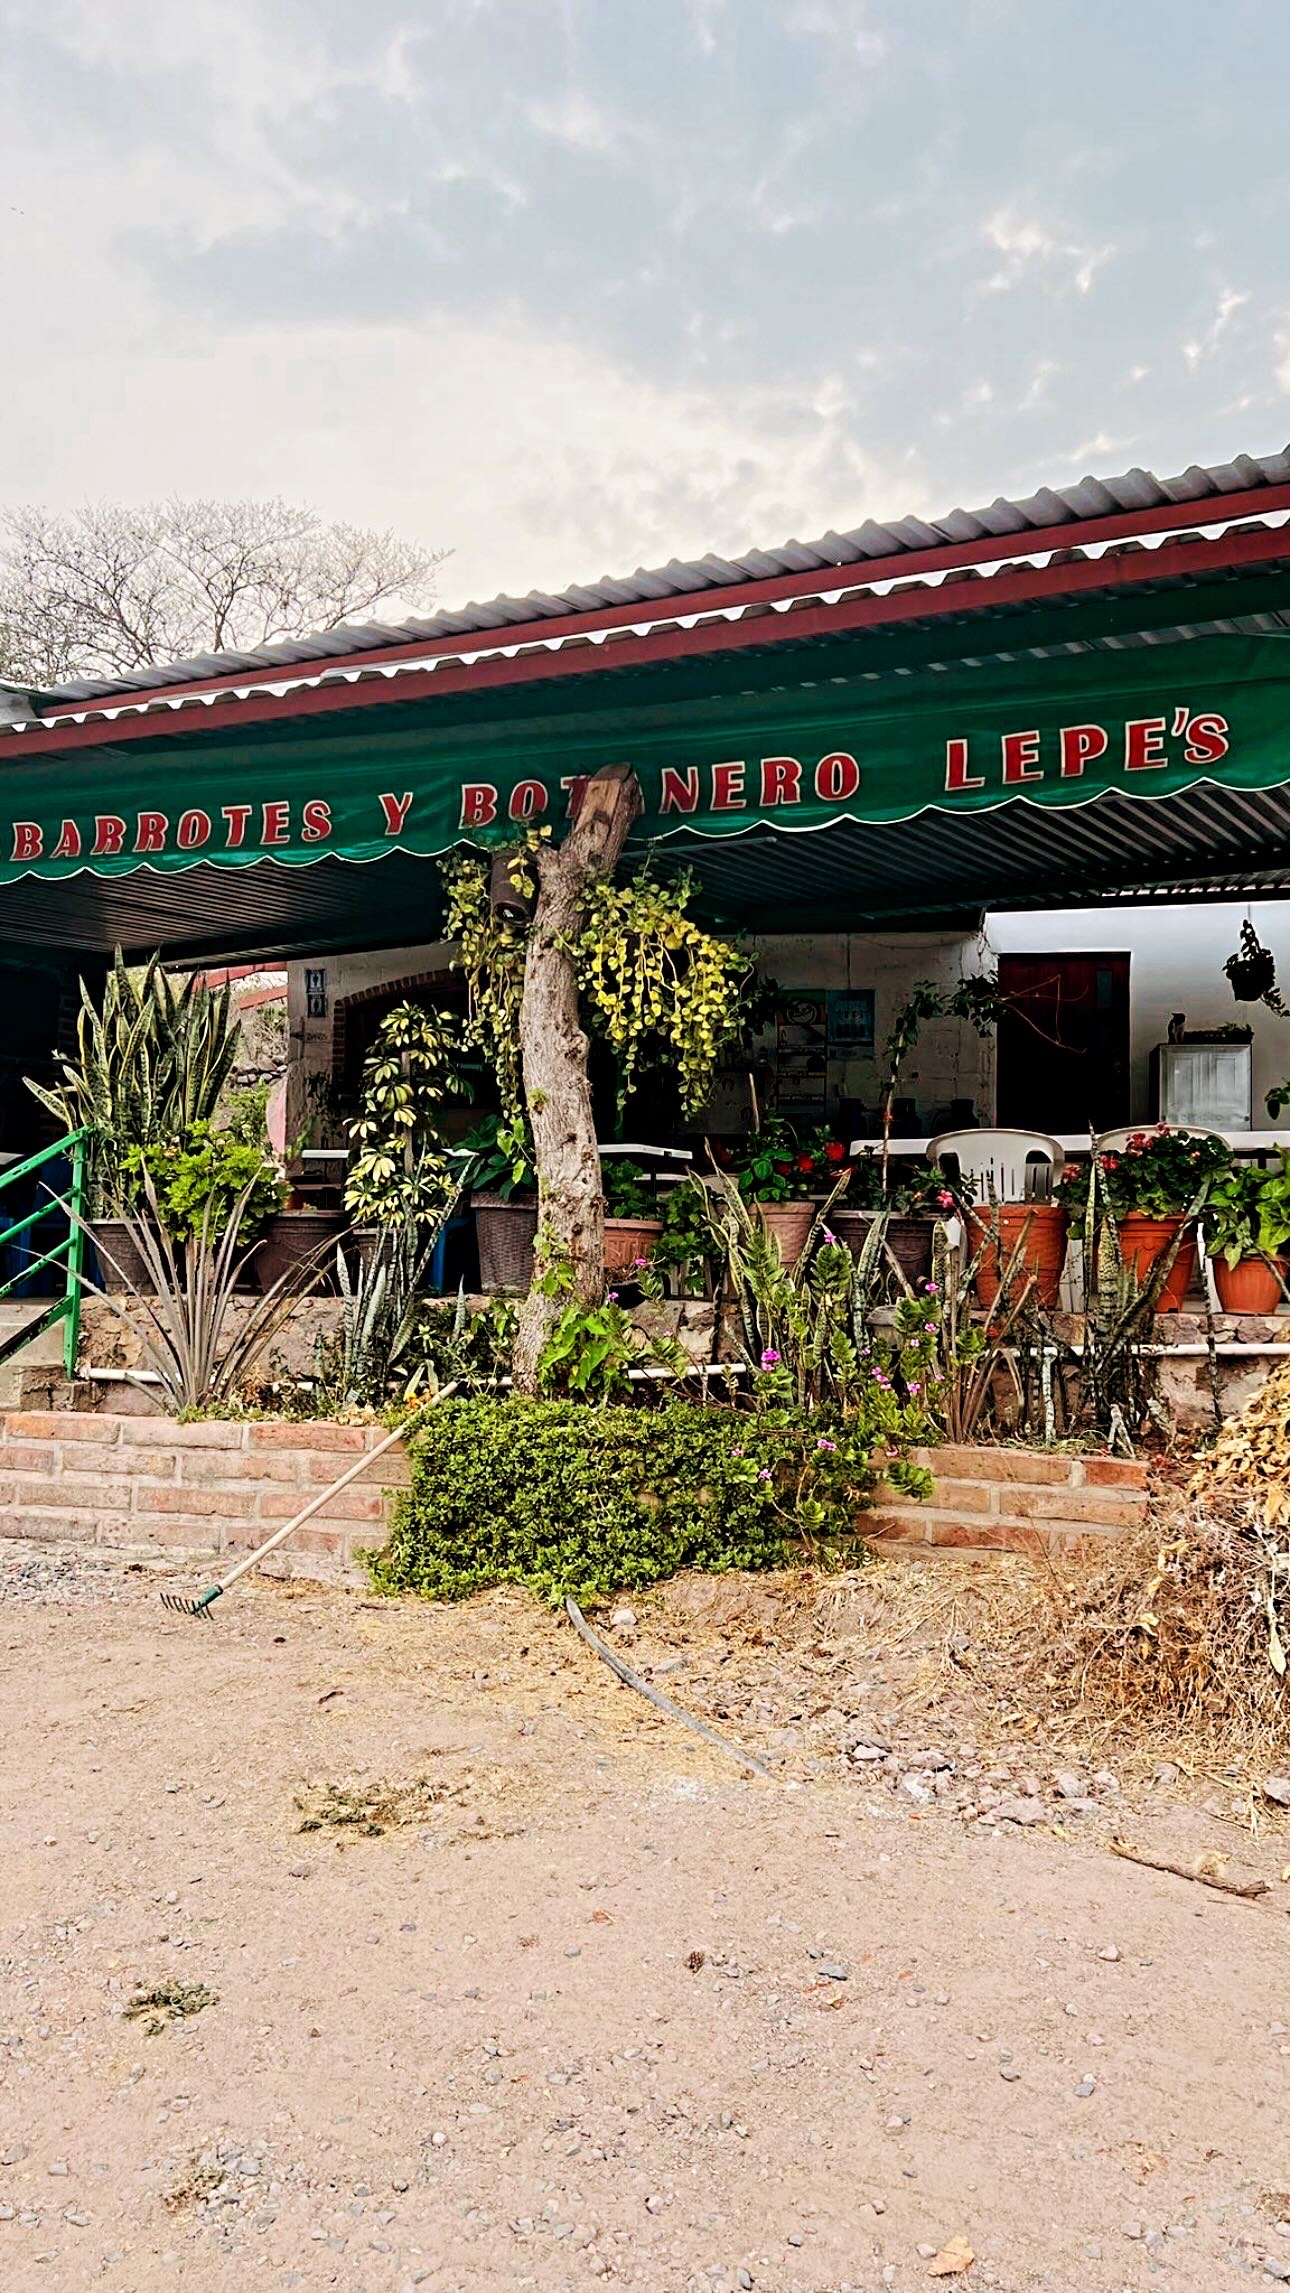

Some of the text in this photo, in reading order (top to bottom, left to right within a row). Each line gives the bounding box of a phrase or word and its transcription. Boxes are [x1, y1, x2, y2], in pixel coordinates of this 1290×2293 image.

[10, 707, 1229, 861] BARROTES Y BOTNERO LEPE'S
